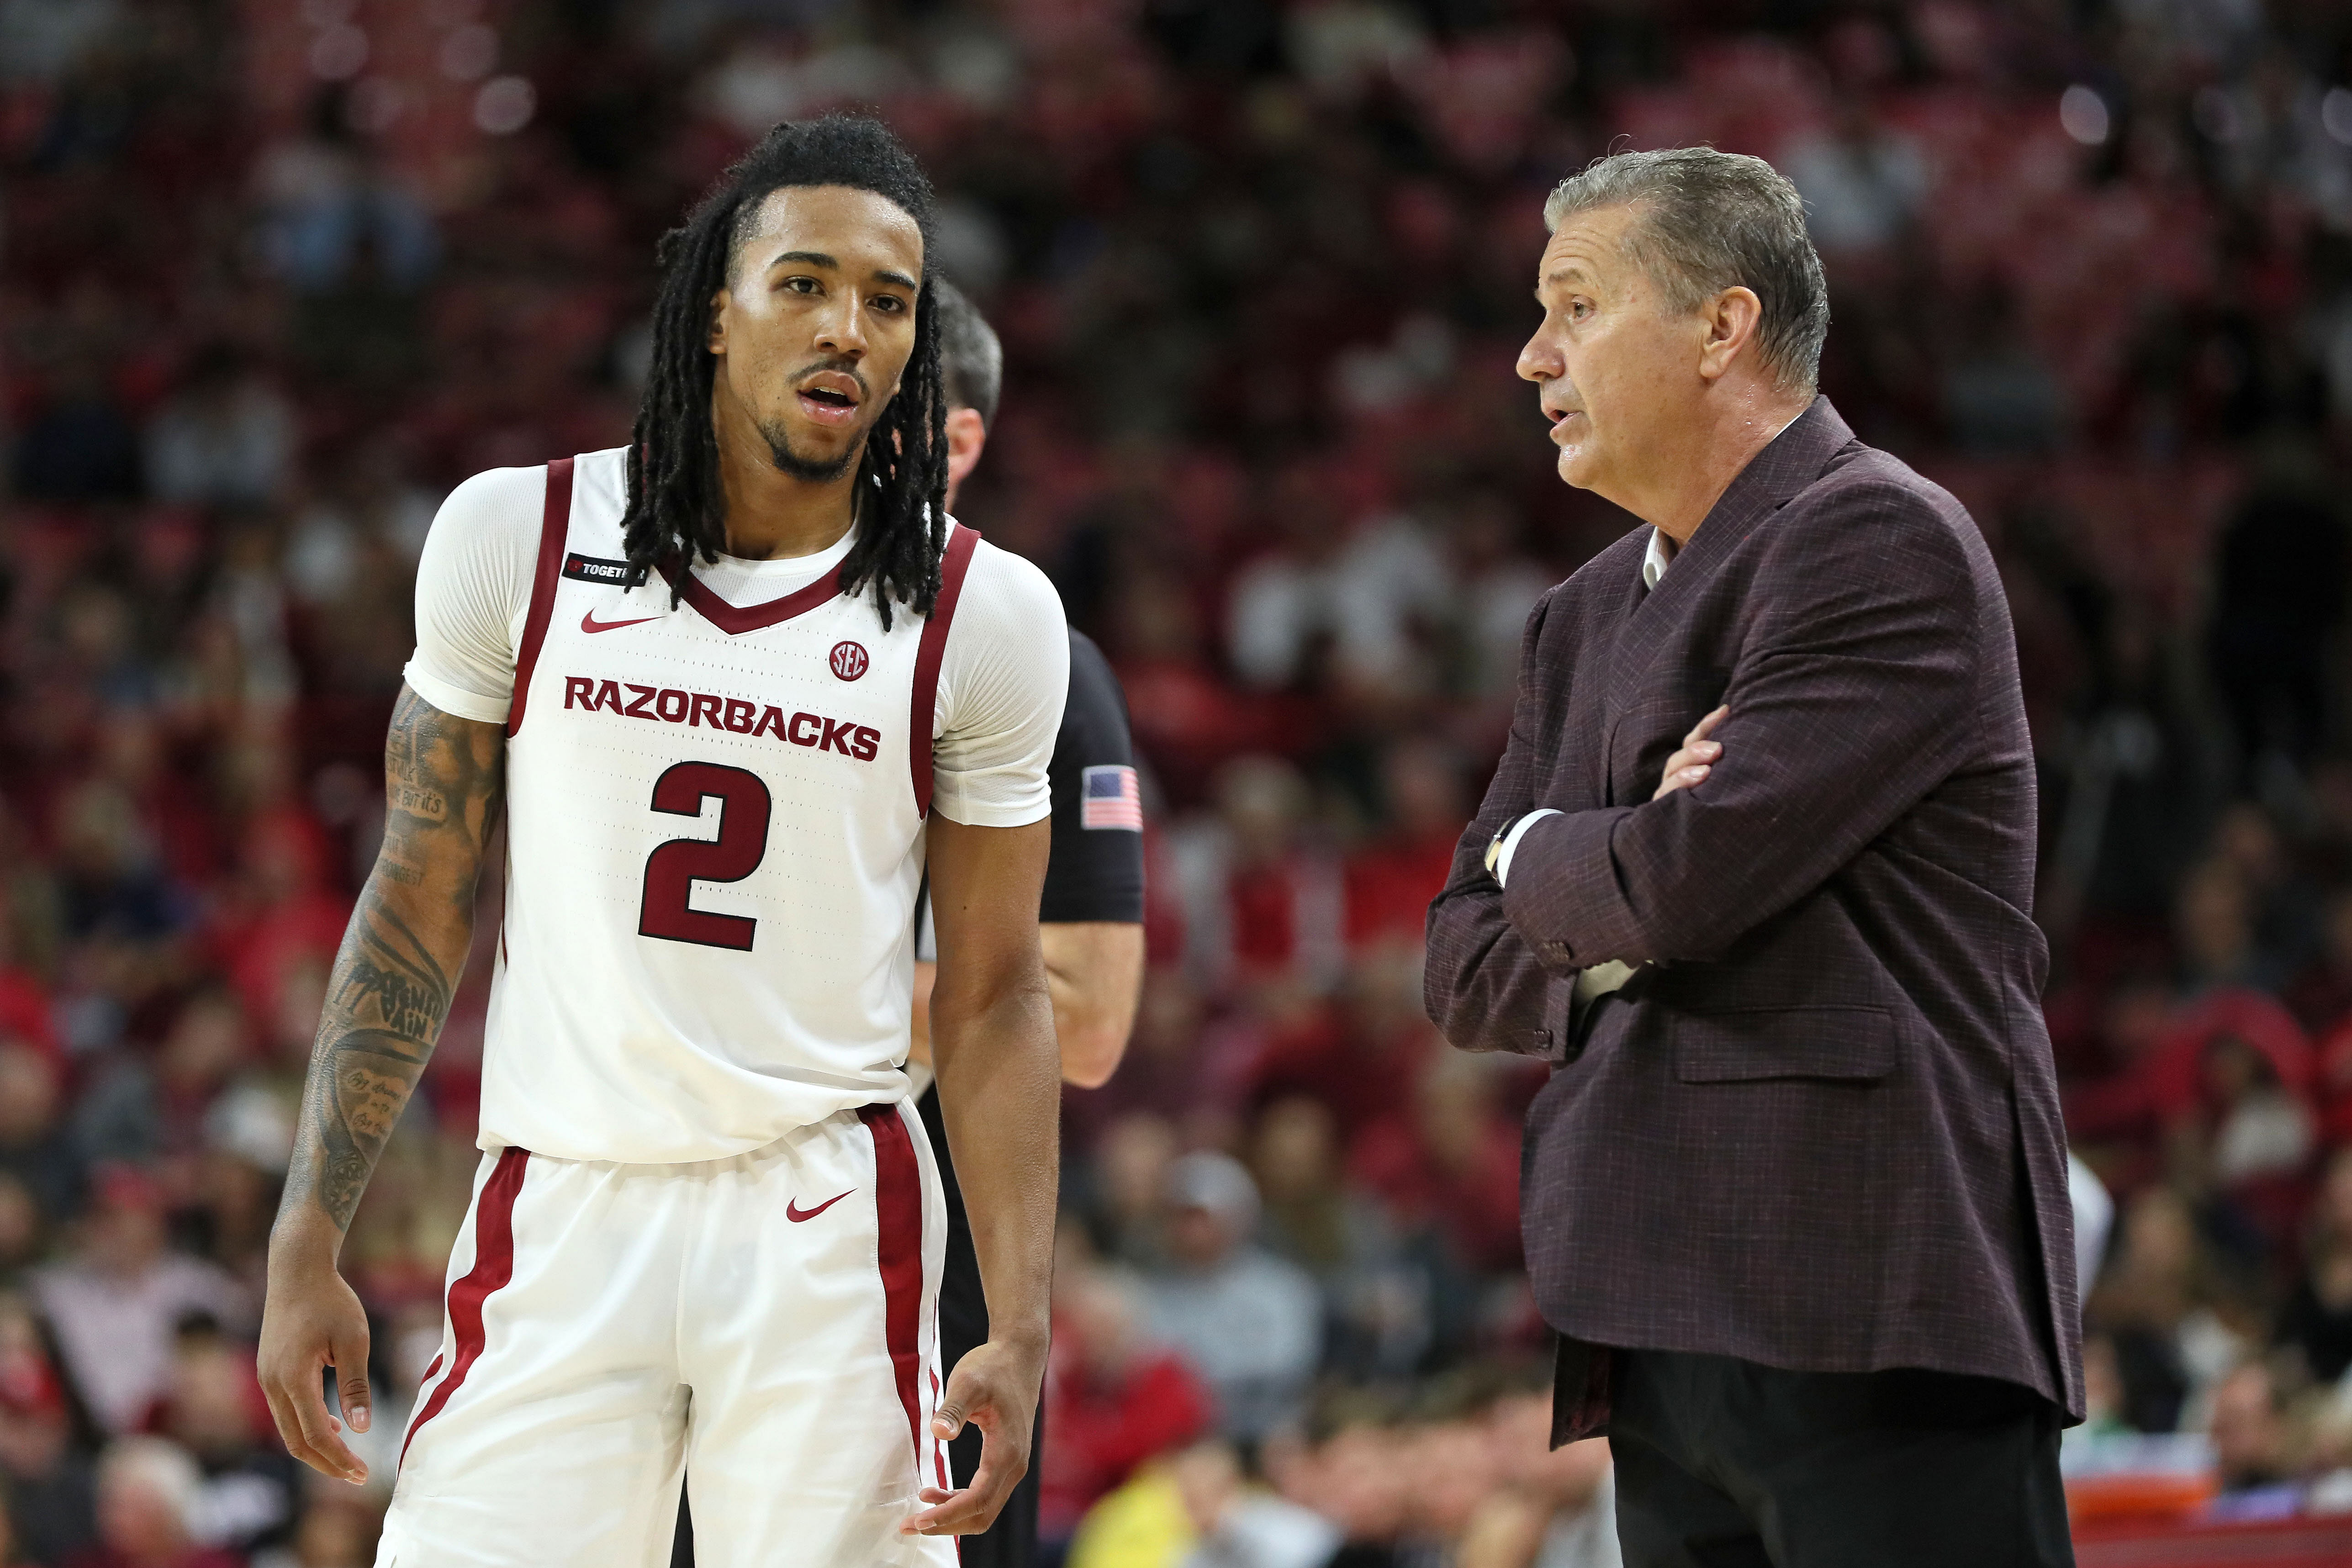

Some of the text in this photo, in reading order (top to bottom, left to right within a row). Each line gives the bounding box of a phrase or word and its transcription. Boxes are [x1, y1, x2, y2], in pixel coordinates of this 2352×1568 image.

[833, 644, 866, 677] SEC
[564, 676, 881, 762] RAZORBACKS
[638, 760, 772, 952] 2
